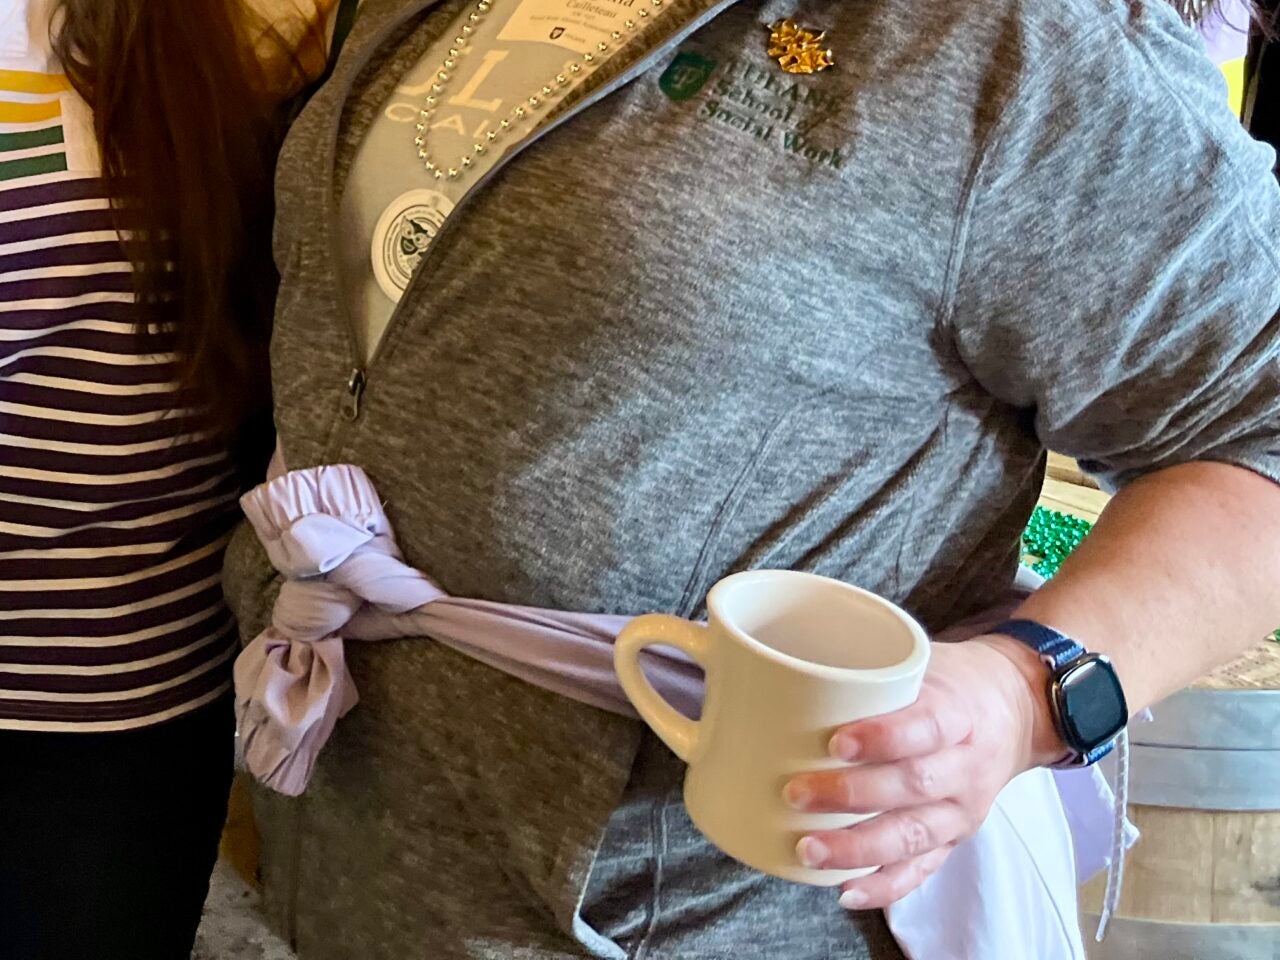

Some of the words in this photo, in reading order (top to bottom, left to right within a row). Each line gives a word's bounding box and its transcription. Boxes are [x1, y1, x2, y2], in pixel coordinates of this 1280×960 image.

[714, 80, 797, 124] School
[722, 59, 845, 114] TULANE
[700, 99, 772, 142] Social
[782, 128, 844, 170] Work
